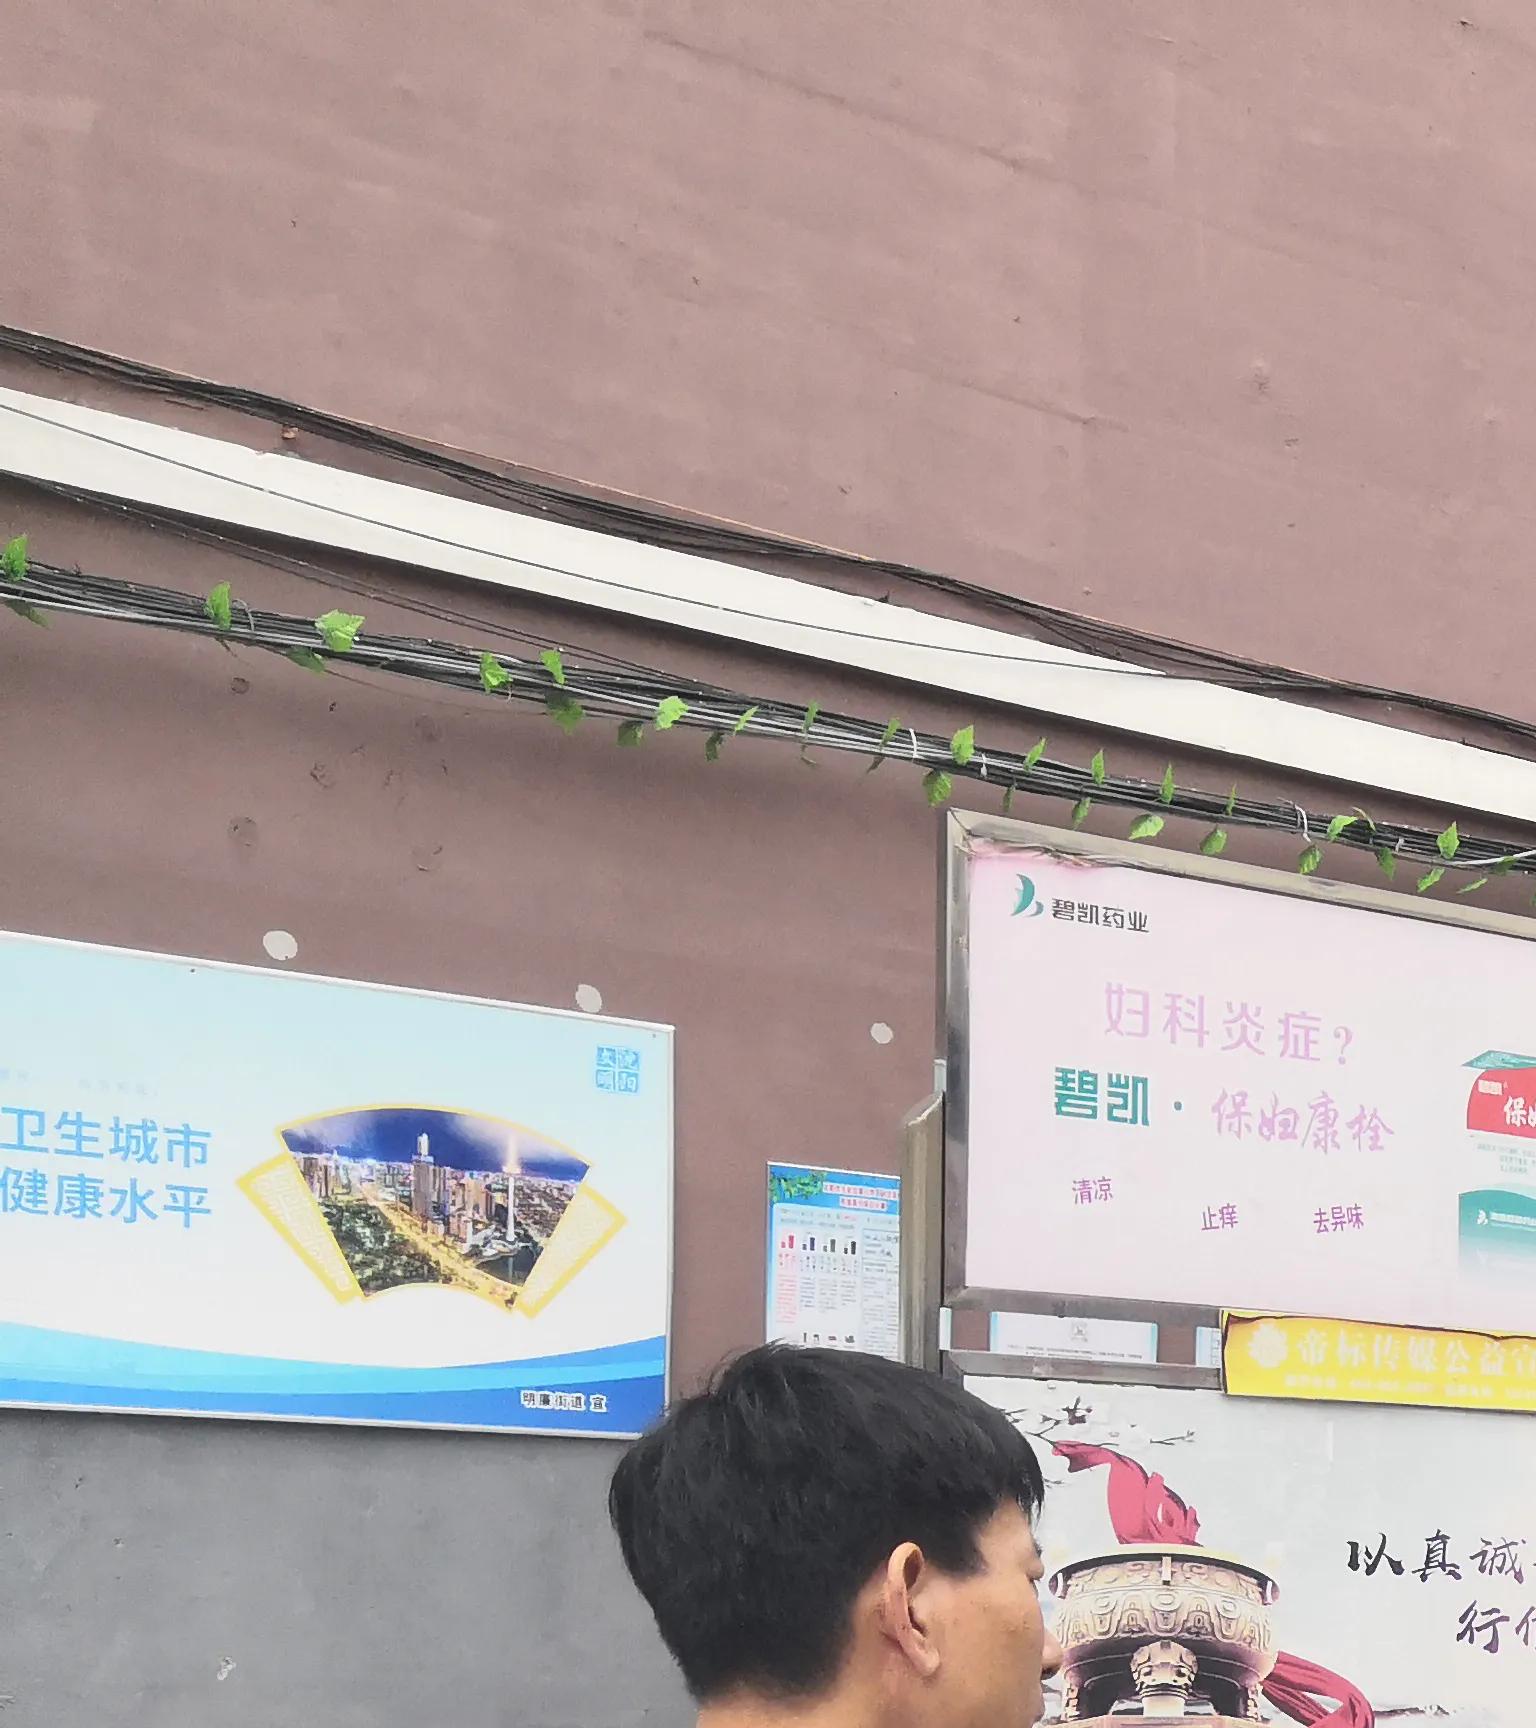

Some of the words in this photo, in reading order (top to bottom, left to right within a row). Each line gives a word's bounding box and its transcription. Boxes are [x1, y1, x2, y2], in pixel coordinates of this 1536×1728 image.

[1052, 898, 1149, 933] 碧凯药业
[1072, 1176, 1114, 1205] 清凉
[1201, 1203, 1240, 1231] 止痒
[1313, 1203, 1364, 1234] 去异味
